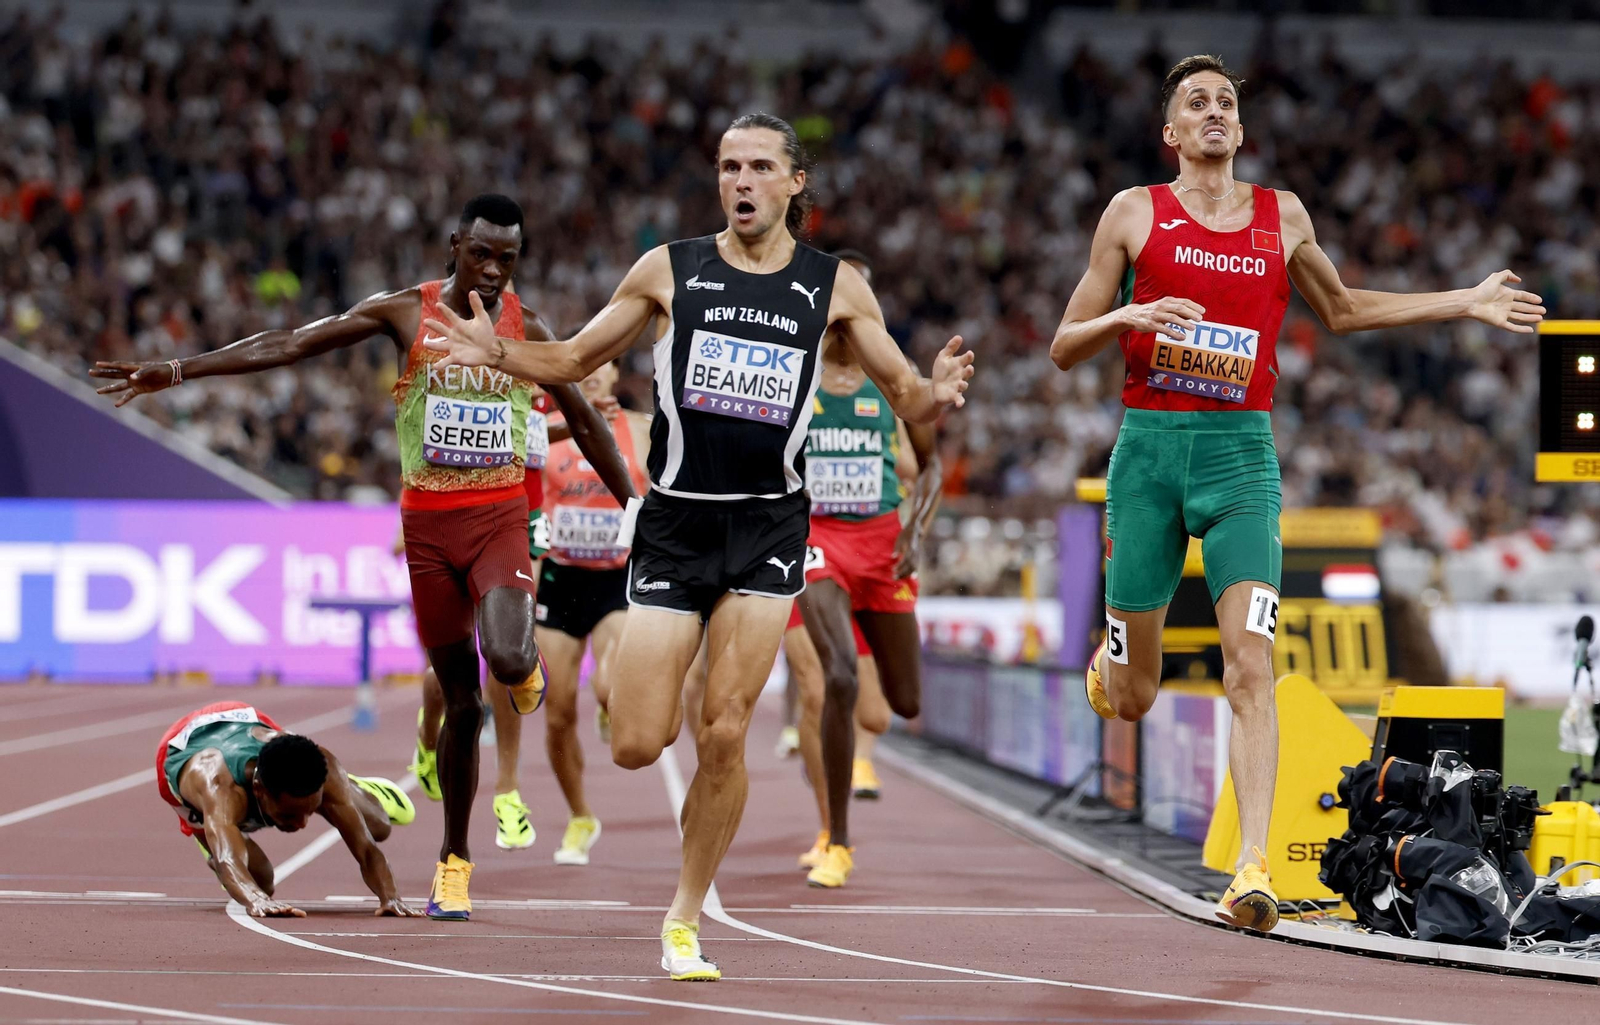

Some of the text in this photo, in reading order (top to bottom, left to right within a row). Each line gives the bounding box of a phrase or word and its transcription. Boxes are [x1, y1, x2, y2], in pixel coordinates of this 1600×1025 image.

[1174, 245, 1266, 277] MOROCCO
[704, 307, 799, 336] NEW ZEALAND
[1193, 325, 1255, 356] TDK
[724, 340, 795, 374] TDK
[1155, 345, 1252, 383] EL BAKKALI
[426, 362, 513, 392] KENYA
[692, 363, 793, 403] BEAMISH
[453, 403, 507, 425] TDK
[429, 424, 507, 449] SEREM
[827, 461, 876, 478] TDK
[811, 480, 877, 498] GIRMA
[0, 543, 267, 644] TDK
